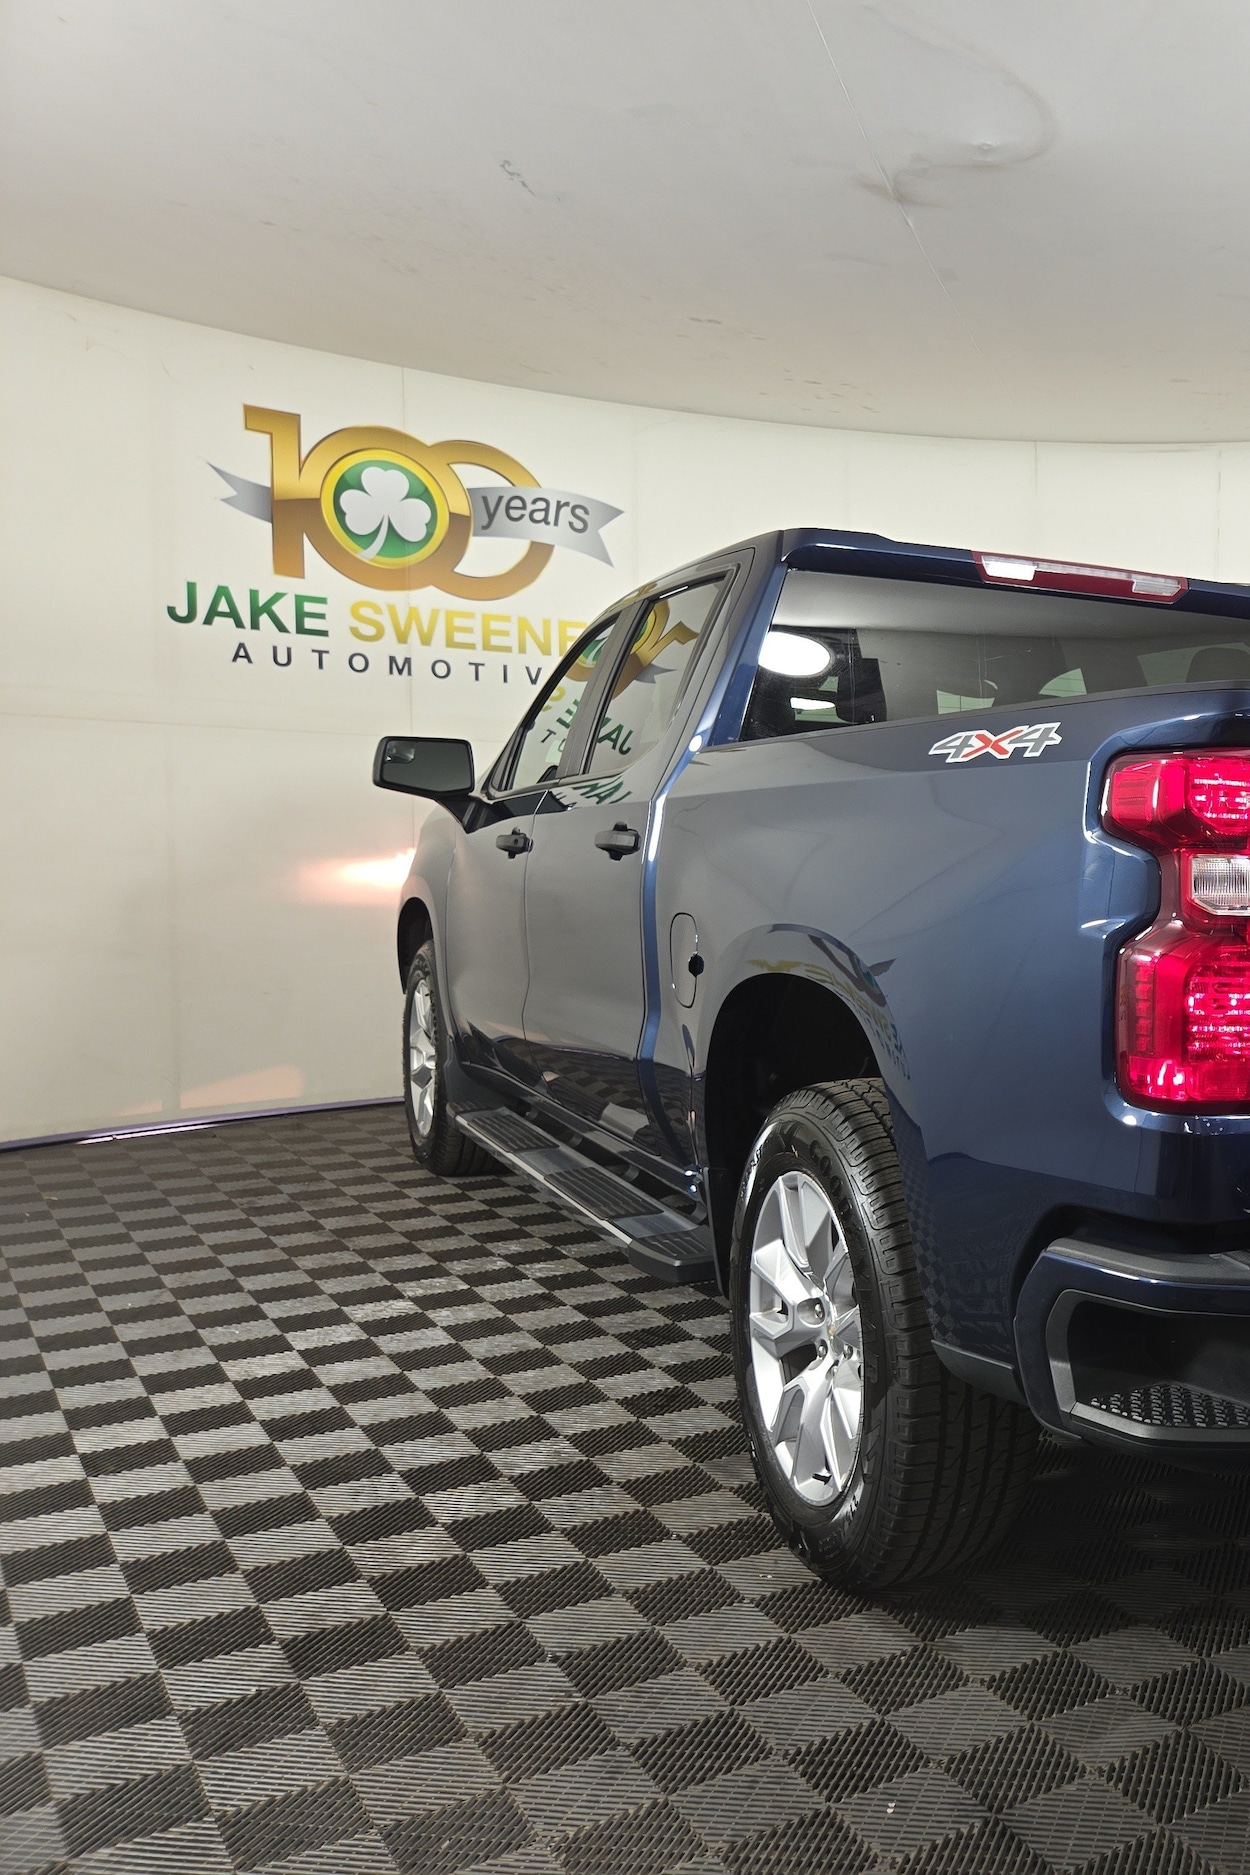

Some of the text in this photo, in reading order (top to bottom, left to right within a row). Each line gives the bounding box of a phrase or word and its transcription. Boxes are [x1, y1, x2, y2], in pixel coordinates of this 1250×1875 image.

[480, 492, 592, 534] years
[166, 581, 330, 638] JAKE
[350, 600, 588, 658] SWEENE
[231, 642, 542, 687] AUTOMOTIV
